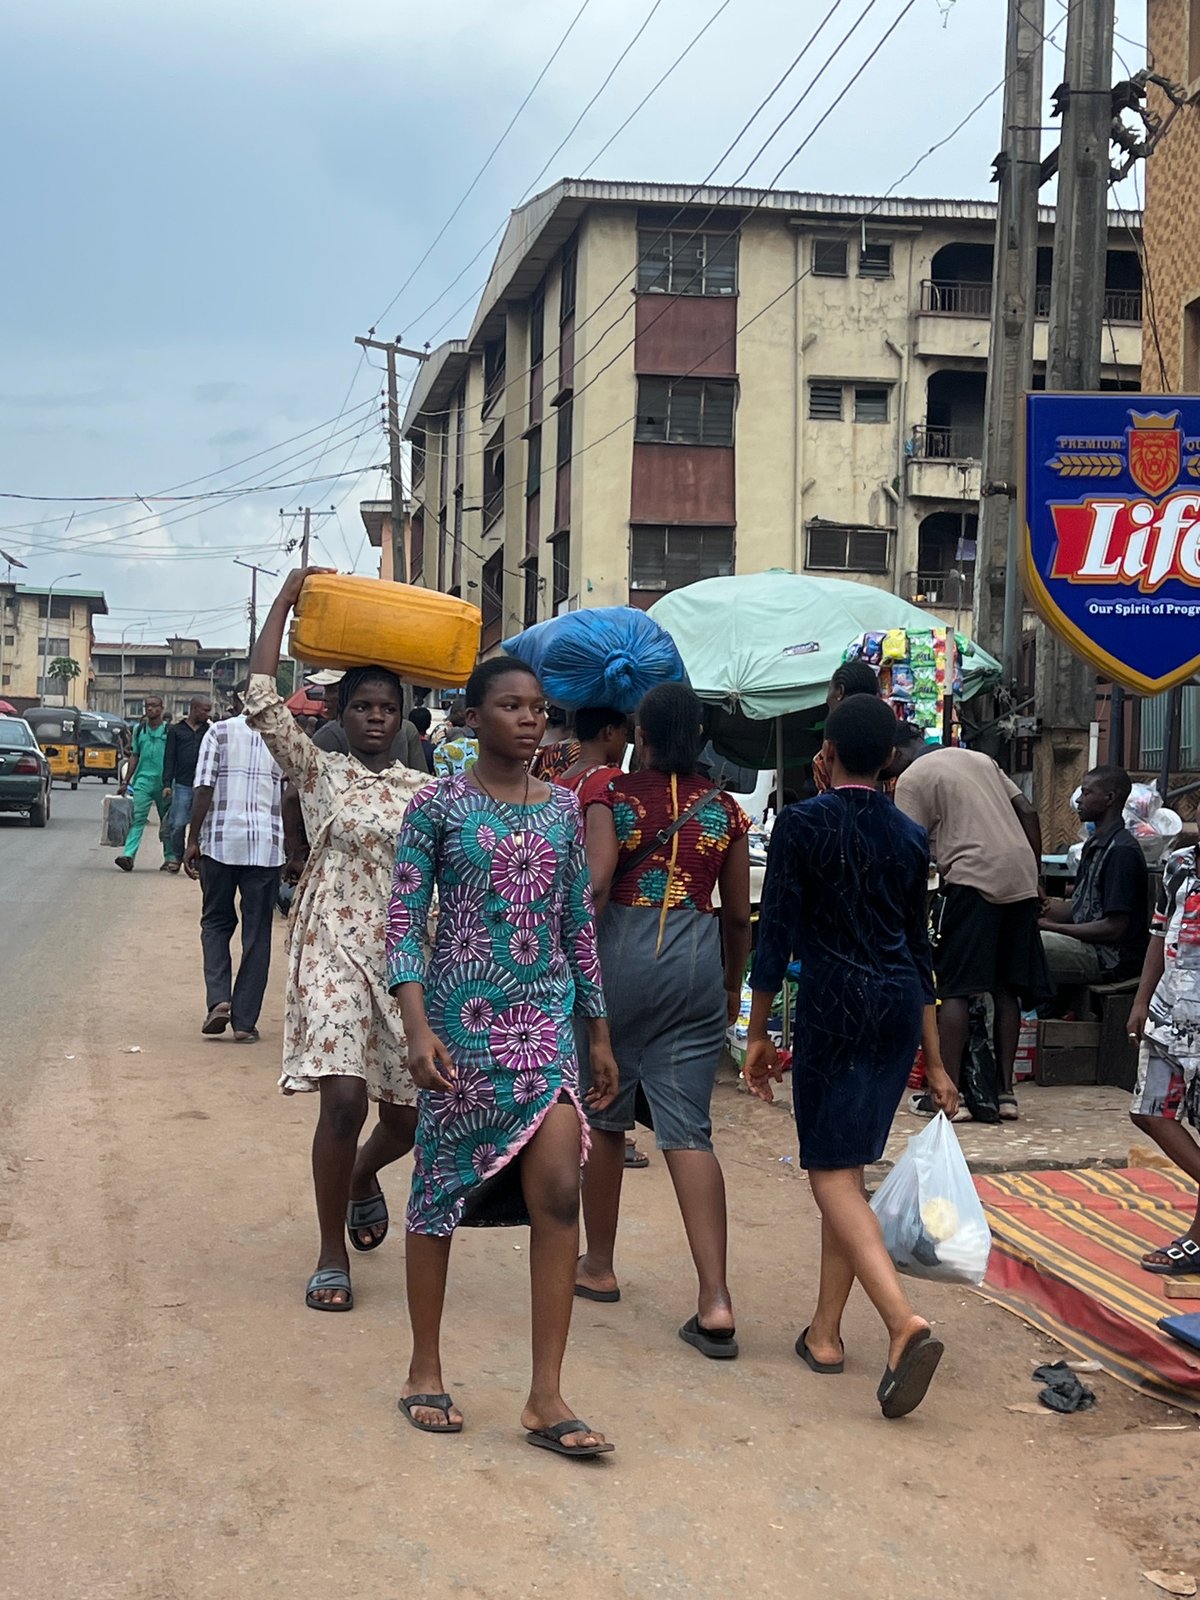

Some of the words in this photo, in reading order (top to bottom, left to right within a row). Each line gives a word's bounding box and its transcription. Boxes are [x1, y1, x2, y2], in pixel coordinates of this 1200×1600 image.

[1060, 439, 1121, 449] PREMIUM
[1089, 603, 1114, 614] Our
[1115, 603, 1150, 616] Spirit
[1152, 604, 1164, 614] of
